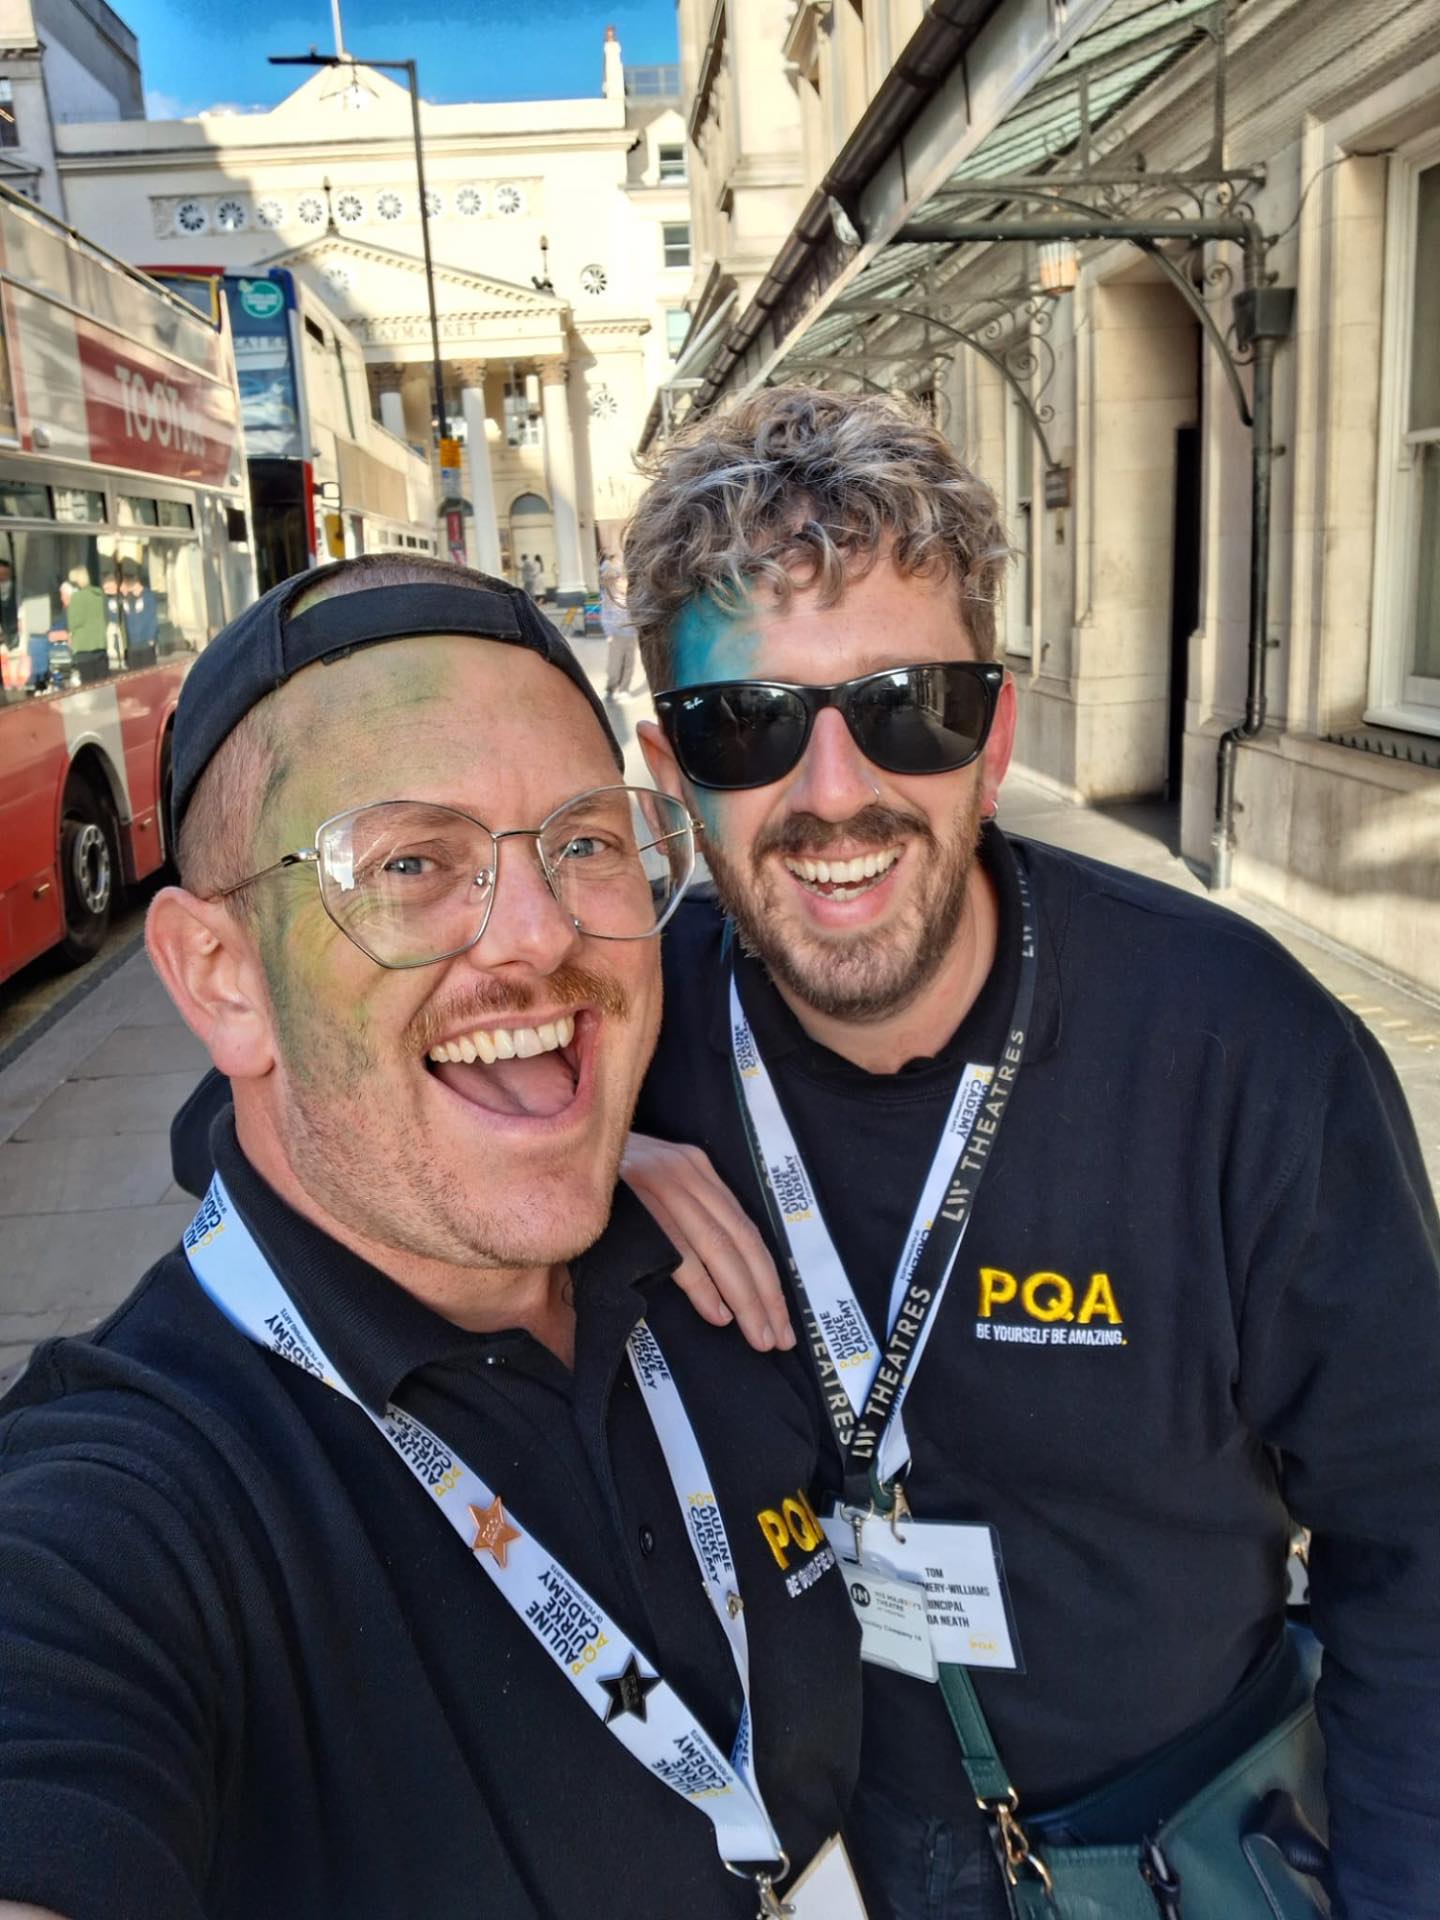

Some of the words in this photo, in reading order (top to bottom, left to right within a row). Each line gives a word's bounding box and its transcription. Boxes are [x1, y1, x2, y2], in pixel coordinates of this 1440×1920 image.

[961, 1029, 1025, 1171] THEATRES
[979, 1267, 1123, 1324] PQA
[866, 1285, 931, 1417] THEATRES
[976, 1323, 991, 1340] BE
[992, 1325, 1050, 1344] YOURSELF
[1051, 1328, 1067, 1345] BE
[1068, 1329, 1127, 1346] AMAZING.
[922, 1582, 990, 1597] MERY-WILLIAMS
[925, 1567, 944, 1578] TOM
[525, 1601, 585, 1675] PAULINE
[538, 1571, 608, 1648] ACADEMY
[543, 1596, 597, 1663] QUIRKE
[940, 1616, 970, 1627] NEATH
